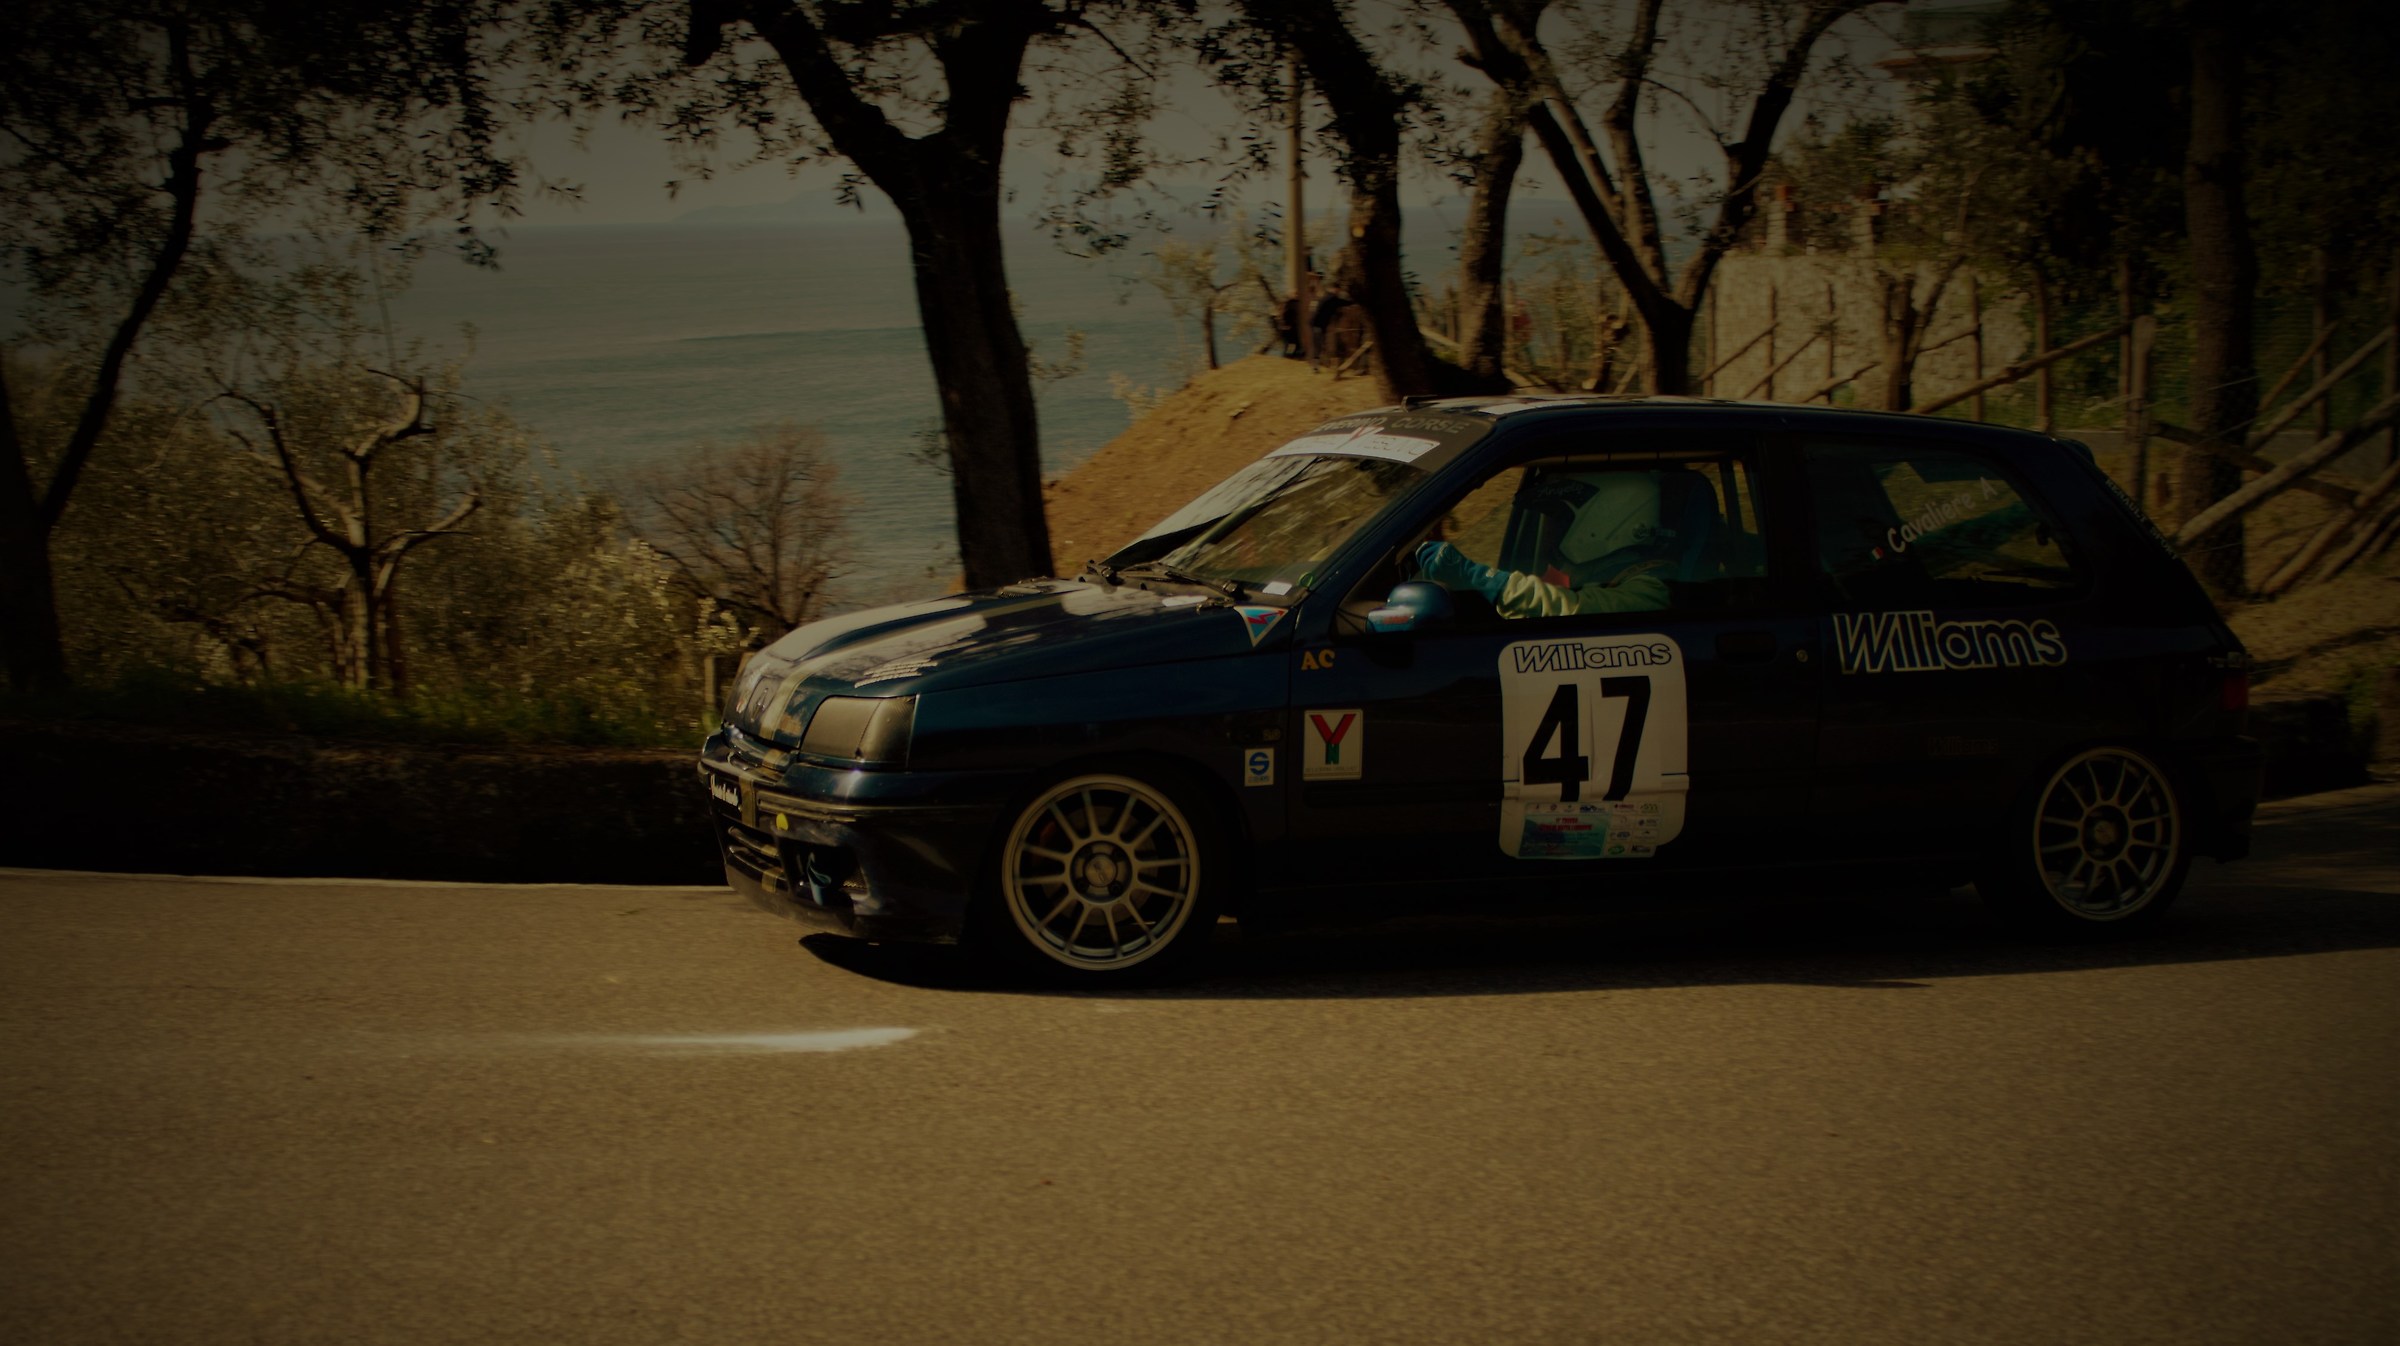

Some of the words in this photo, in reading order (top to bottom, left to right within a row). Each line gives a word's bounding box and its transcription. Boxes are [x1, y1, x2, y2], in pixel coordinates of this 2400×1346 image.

[1391, 416, 1471, 434] CORSE
[1886, 488, 1977, 553] Cavaliere
[2105, 479, 2148, 523] RENAULT
[2150, 526, 2179, 560] SPORT
[1300, 648, 1336, 671] AC
[1513, 643, 1672, 673] Williams
[1831, 609, 2069, 675] Williams
[1523, 675, 1651, 802] 47
